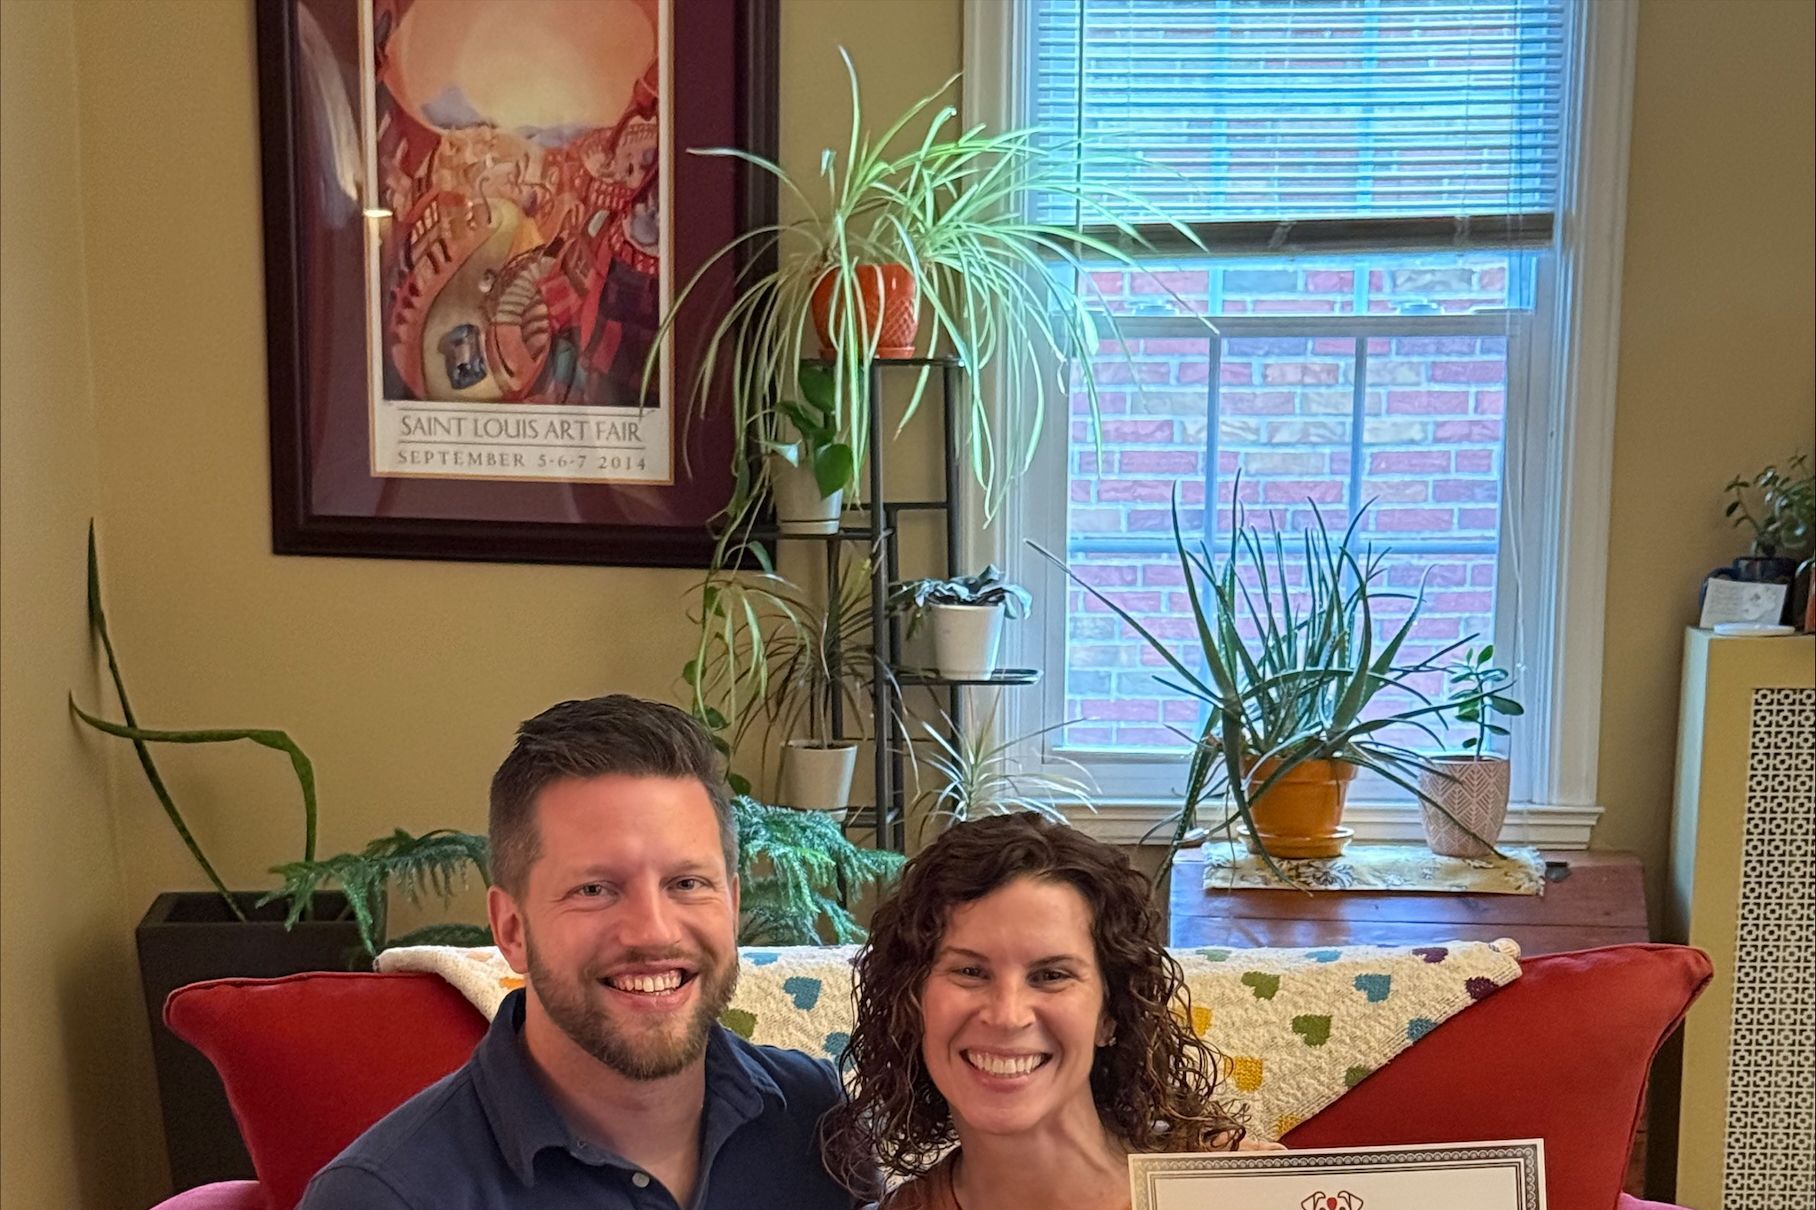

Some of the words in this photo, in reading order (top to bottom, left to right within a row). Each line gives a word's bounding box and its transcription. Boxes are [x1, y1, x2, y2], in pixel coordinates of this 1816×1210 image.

[401, 415, 468, 438] SAINT
[473, 418, 538, 440] LOUIS
[544, 420, 590, 441] ART
[595, 421, 642, 442] FAIR
[398, 450, 526, 468] SEPTEMBER
[536, 453, 587, 469] 5-6-7
[597, 455, 647, 471] 2014
